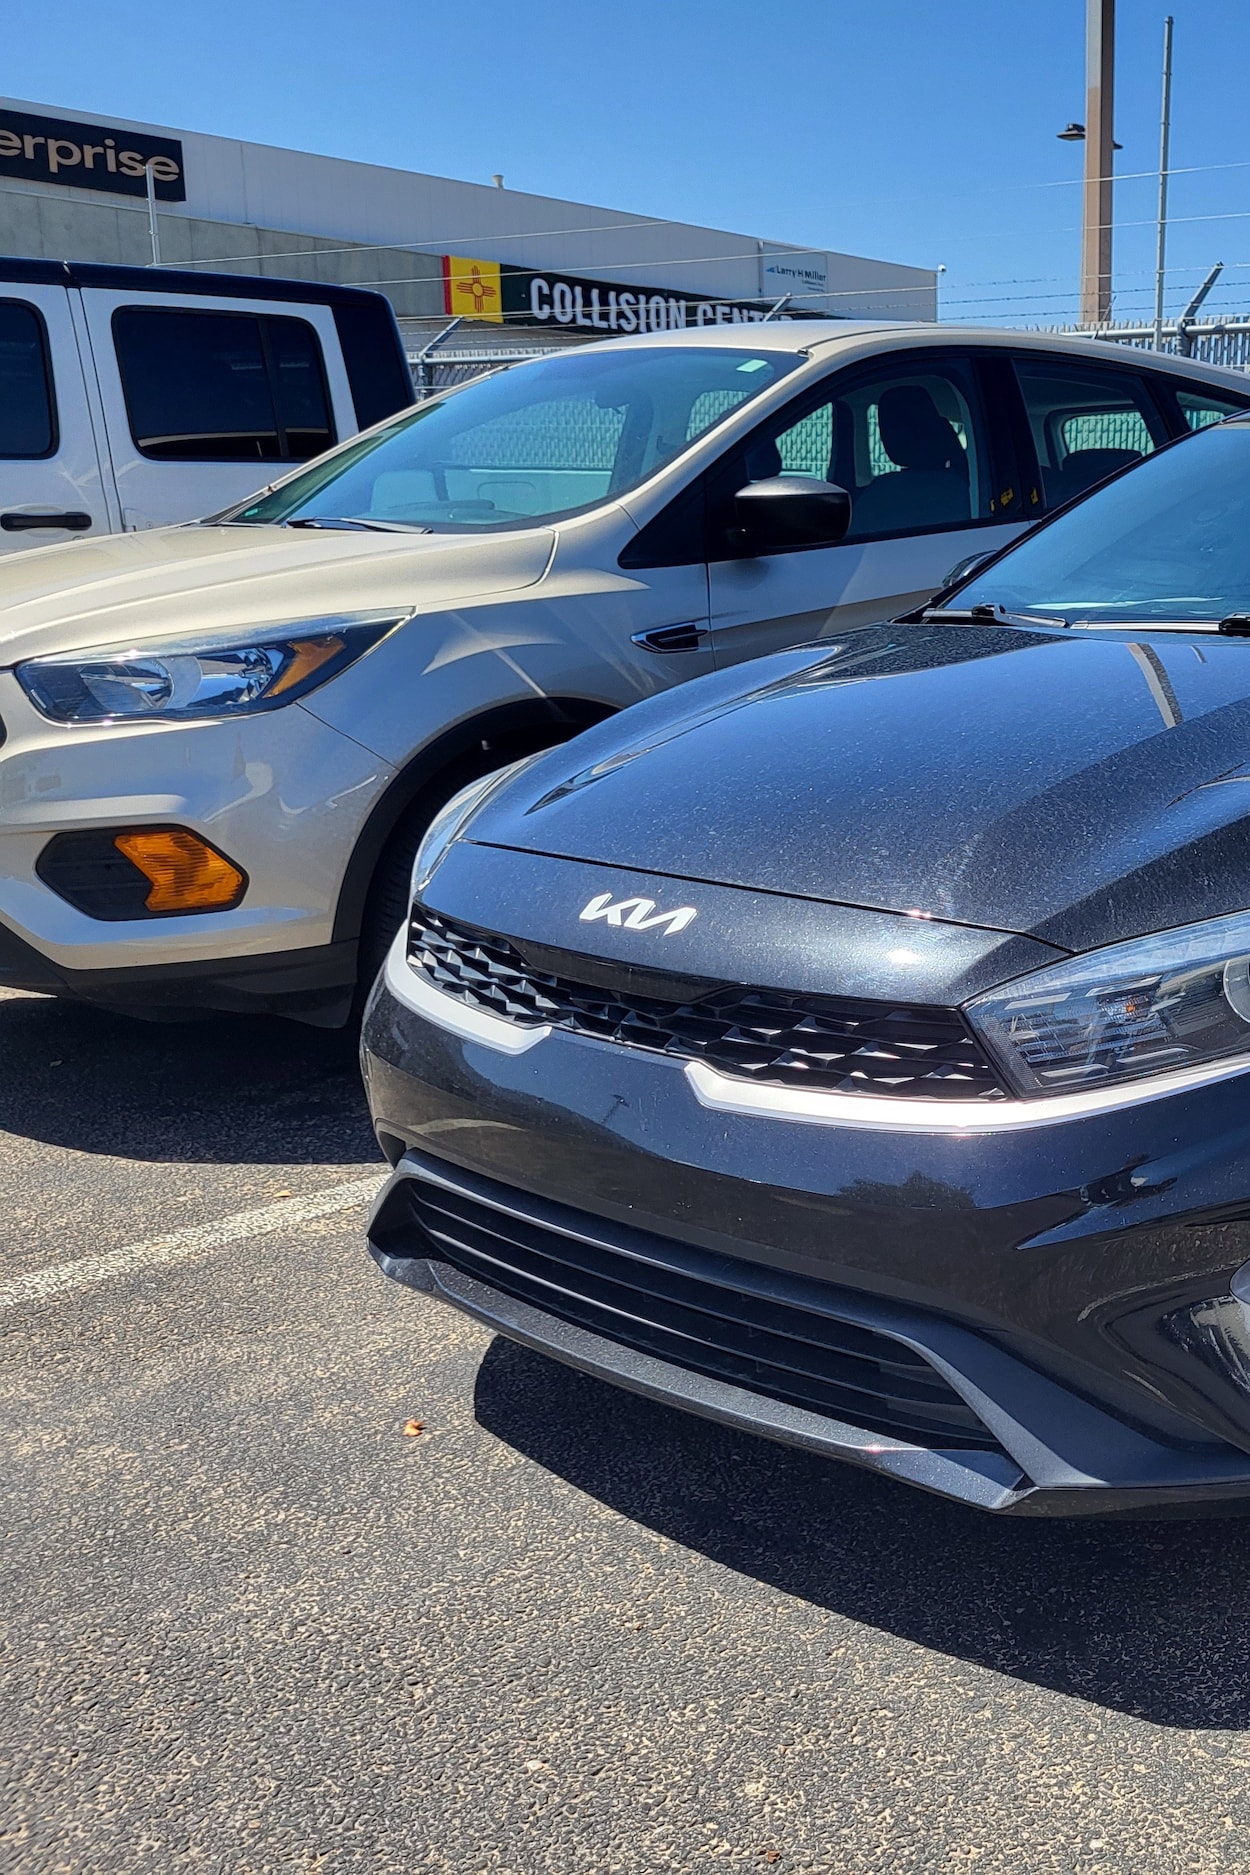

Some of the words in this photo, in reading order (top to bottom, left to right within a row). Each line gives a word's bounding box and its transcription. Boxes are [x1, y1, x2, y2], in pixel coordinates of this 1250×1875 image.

[776, 265, 796, 278] Larry
[798, 269, 804, 278] H
[529, 277, 687, 333] COLLISION
